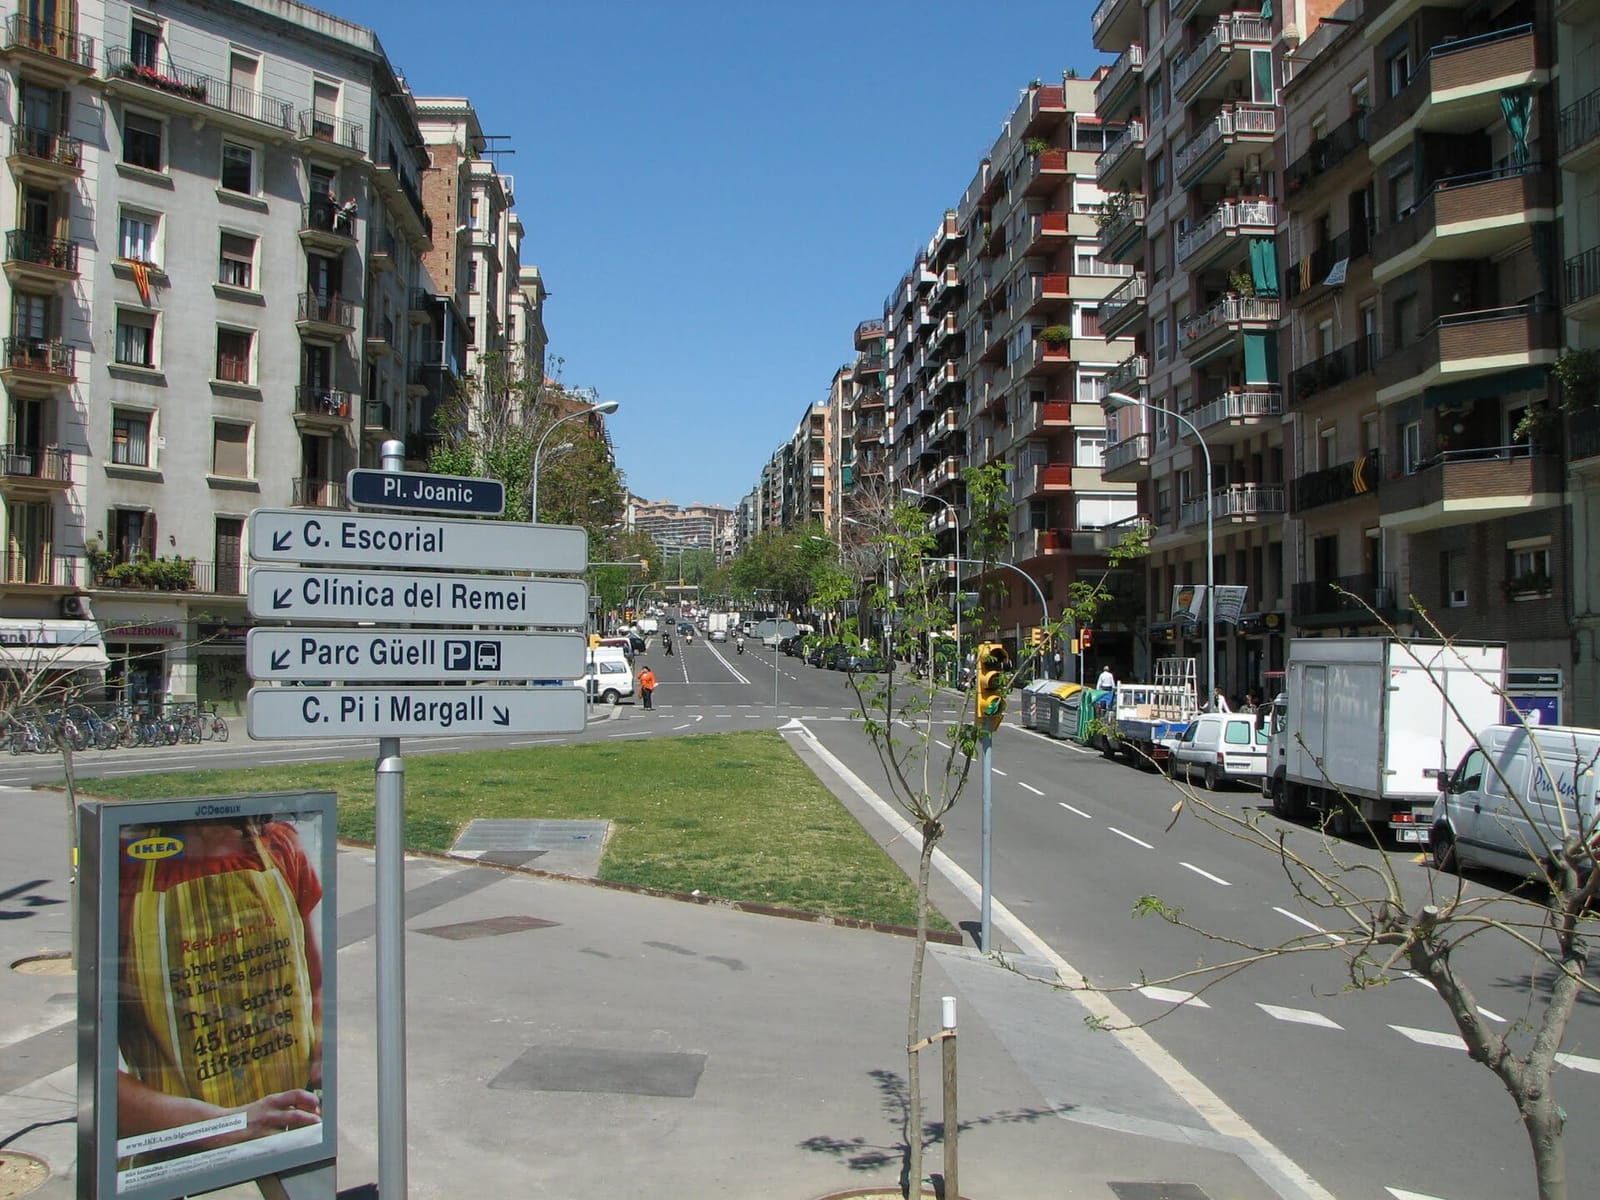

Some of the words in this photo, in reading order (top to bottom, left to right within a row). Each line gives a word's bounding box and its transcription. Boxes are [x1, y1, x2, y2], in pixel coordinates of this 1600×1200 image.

[383, 477, 407, 498] Pl.
[414, 480, 474, 503] Joanic
[303, 520, 330, 547] C.
[341, 522, 444, 553] Escorial
[302, 577, 394, 608] Clínica
[404, 582, 441, 609] del
[452, 583, 527, 611] Remei
[301, 638, 360, 666] Parc
[369, 639, 435, 666] Güell
[302, 696, 329, 723] C.
[341, 696, 364, 722] Pi
[374, 696, 380, 721] i
[391, 695, 483, 727] Margall
[194, 804, 241, 817] JCDecaux
[134, 842, 178, 854] IKEA
[170, 961, 217, 983] Sobre
[222, 943, 272, 971] gustos
[274, 936, 290, 952] no
[222, 971, 245, 986] res
[240, 984, 294, 1011] entre
[193, 1030, 221, 1056] 45
[197, 1033, 299, 1081] diferents.
